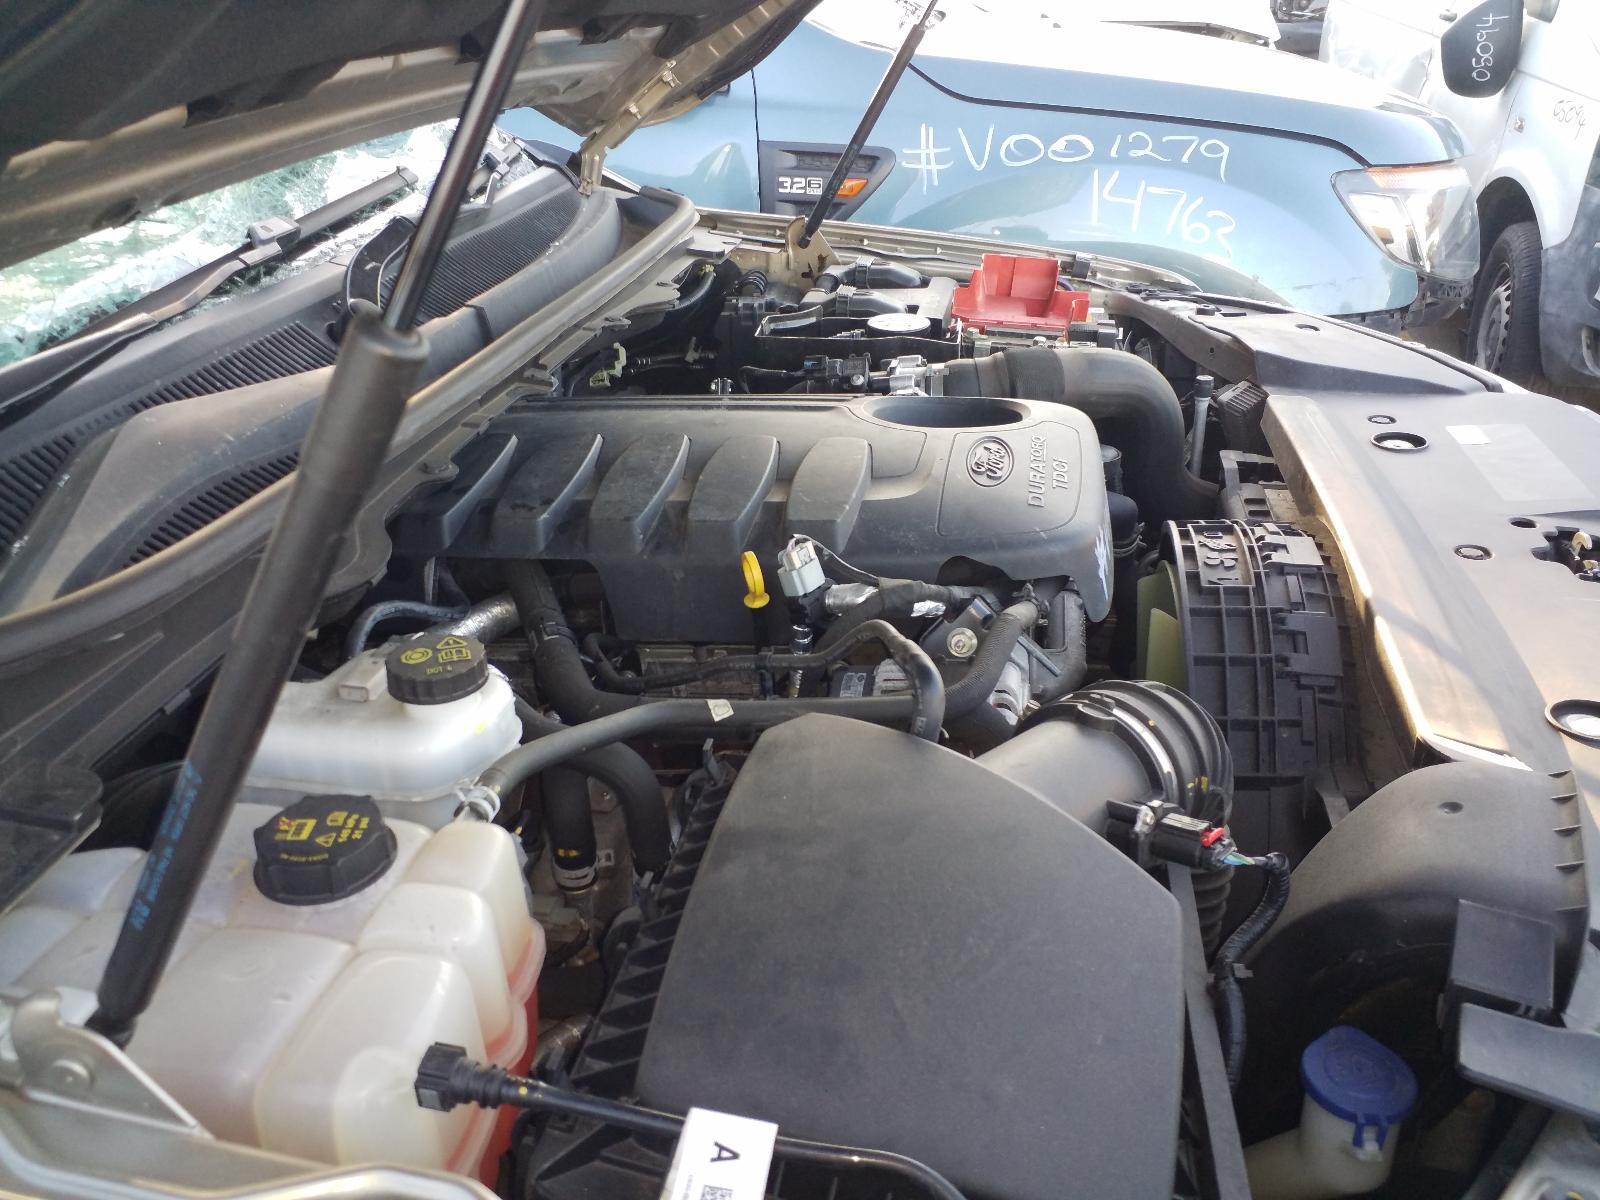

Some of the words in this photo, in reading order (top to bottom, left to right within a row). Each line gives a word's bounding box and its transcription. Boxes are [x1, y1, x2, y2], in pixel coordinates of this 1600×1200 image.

[1472, 13, 1509, 81] 05094
[901, 123, 1230, 195] #V001279
[1091, 168, 1236, 263] 14763
[971, 446, 1006, 480] Ford
[1028, 435, 1046, 507] DURATORQ
[710, 1141, 740, 1162] A
